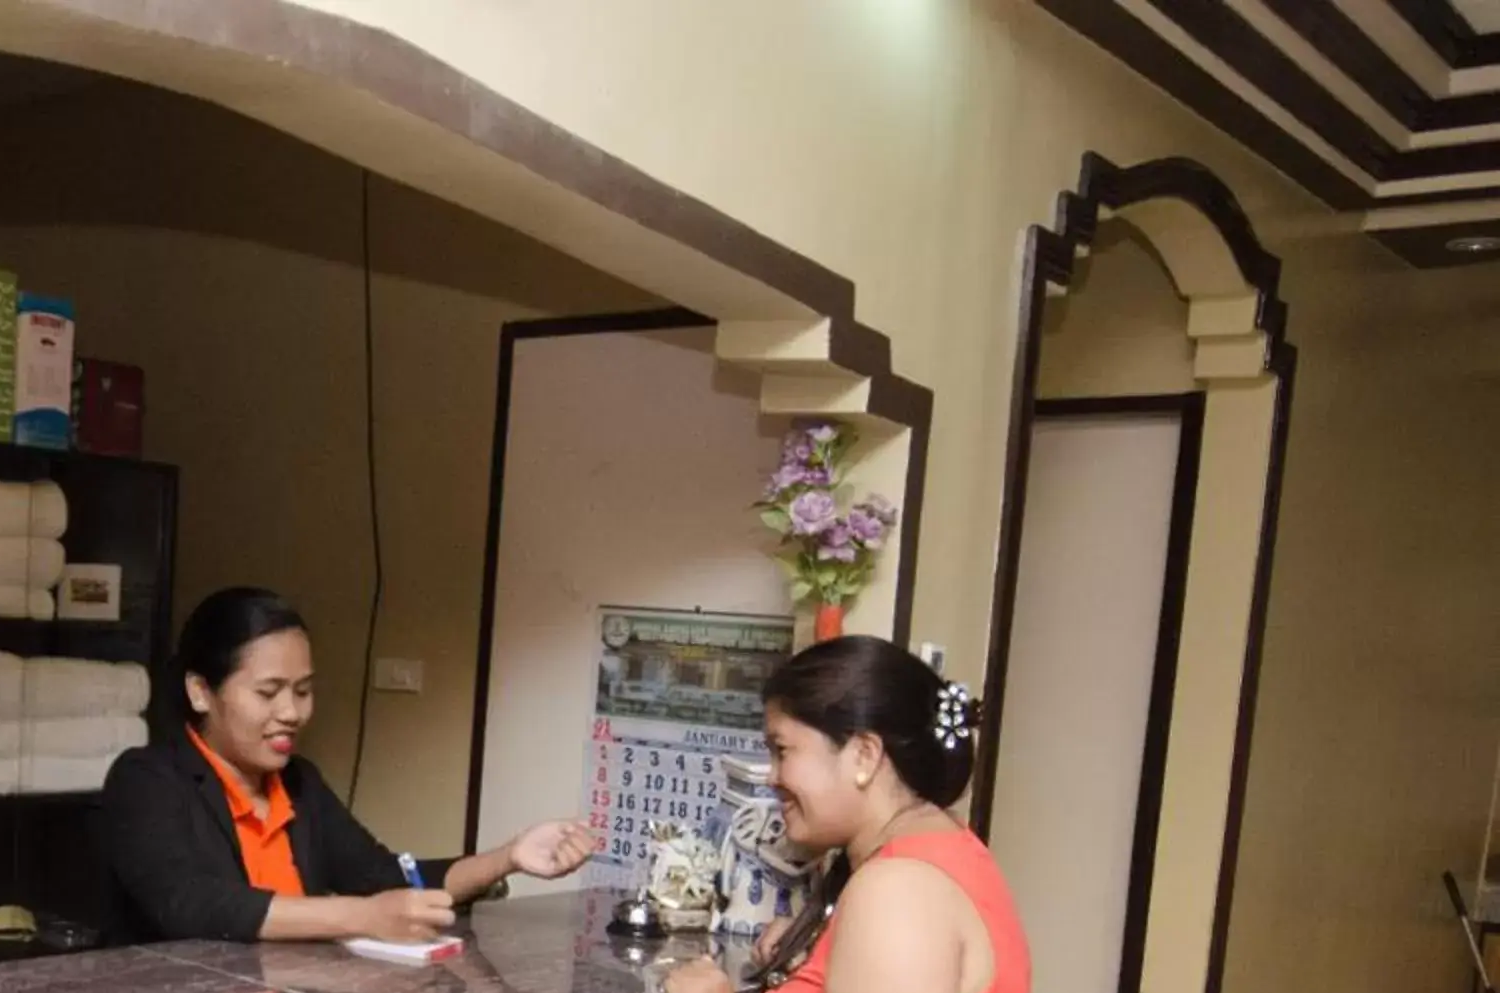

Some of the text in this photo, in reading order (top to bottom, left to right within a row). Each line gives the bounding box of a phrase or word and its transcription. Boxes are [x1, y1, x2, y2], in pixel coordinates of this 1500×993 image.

[684, 730, 747, 748] JANUARY
[599, 744, 713, 774] 1 2 3 4 5
[597, 767, 717, 799] 8 9 10 11 12
[592, 790, 610, 806] 15
[617, 793, 636, 810] 16
[642, 797, 662, 814] 17
[669, 801, 688, 818] 18
[589, 812, 608, 829] 22
[614, 816, 633, 833] 23
[612, 838, 632, 856] 30
